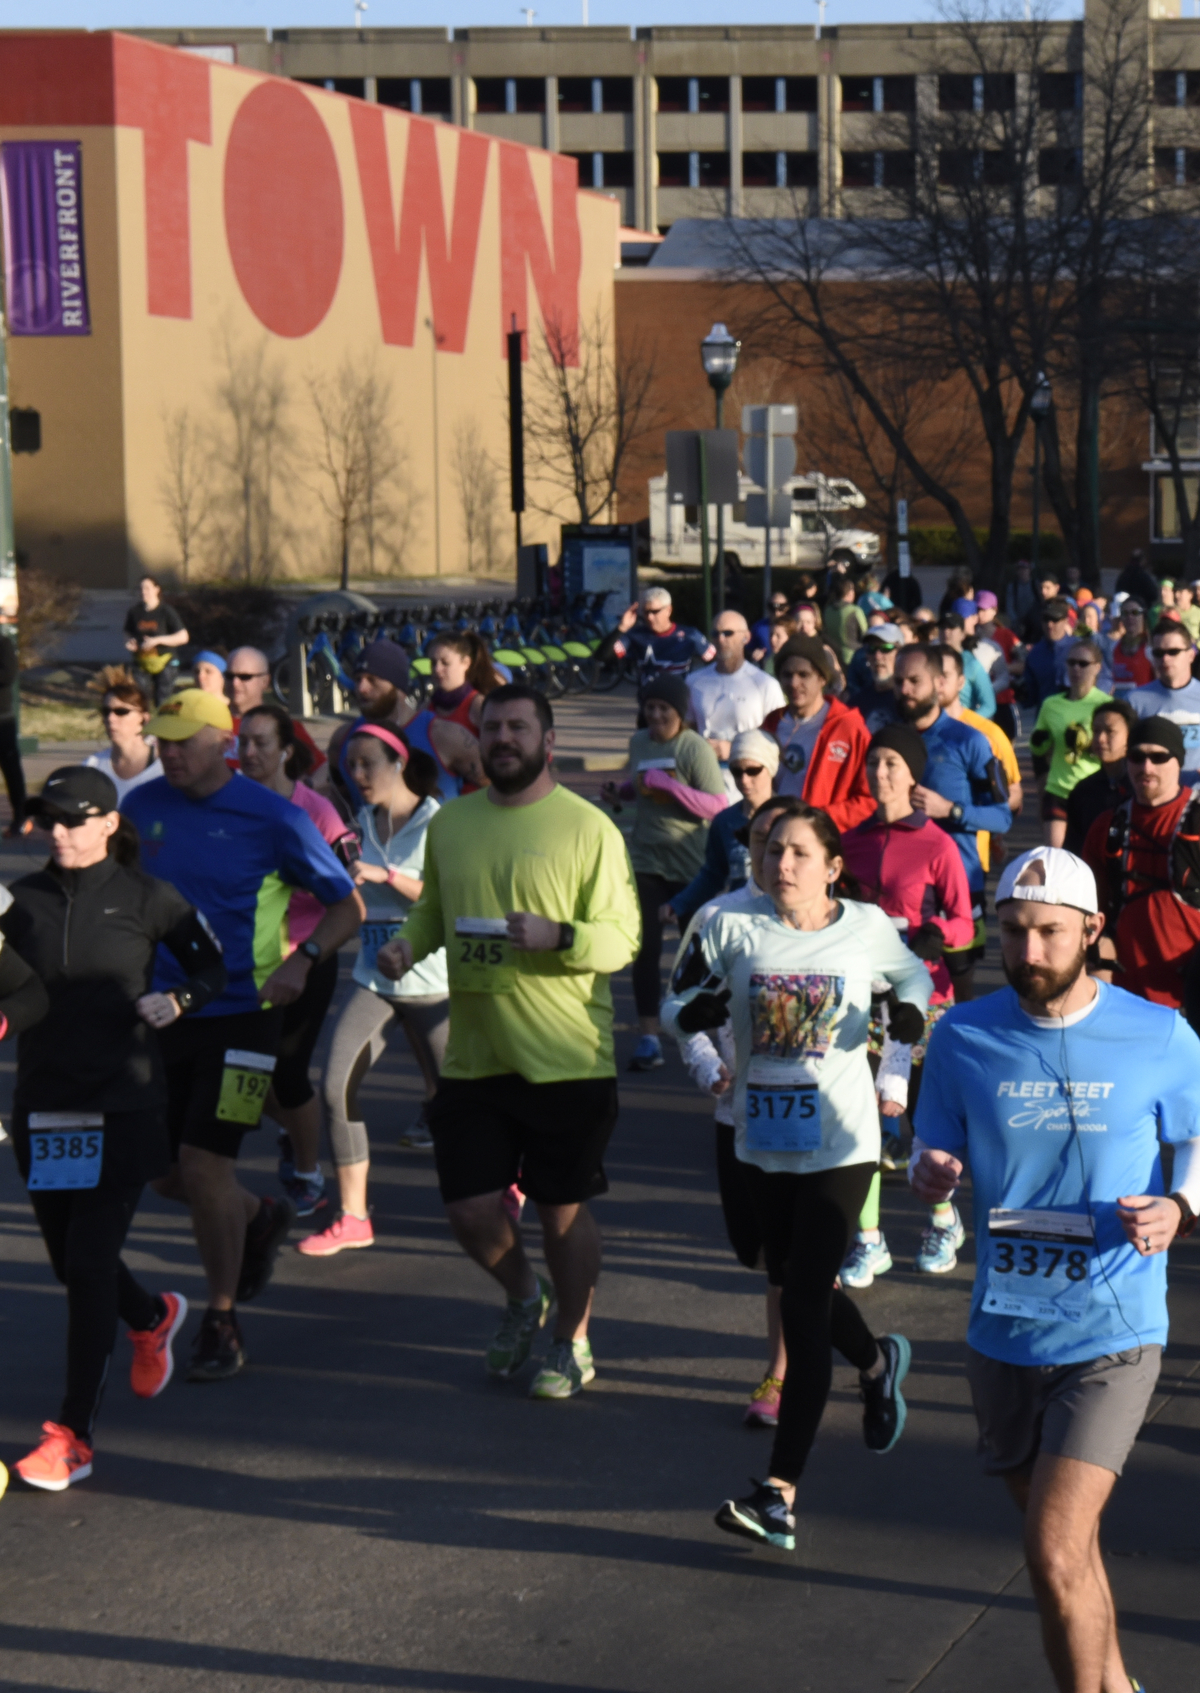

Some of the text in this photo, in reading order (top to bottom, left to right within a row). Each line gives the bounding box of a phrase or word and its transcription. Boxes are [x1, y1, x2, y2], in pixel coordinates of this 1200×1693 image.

[114, 33, 582, 368] TOWN
[55, 150, 82, 327] RIVERFRONT
[460, 941, 503, 964] 245
[997, 1081, 1114, 1098] FLEET FEET
[748, 1094, 816, 1119] 3175
[1046, 1123, 1107, 1131] CHATTNOOGA
[35, 1135, 98, 1160] 3385
[994, 1243, 1087, 1282] 3378
